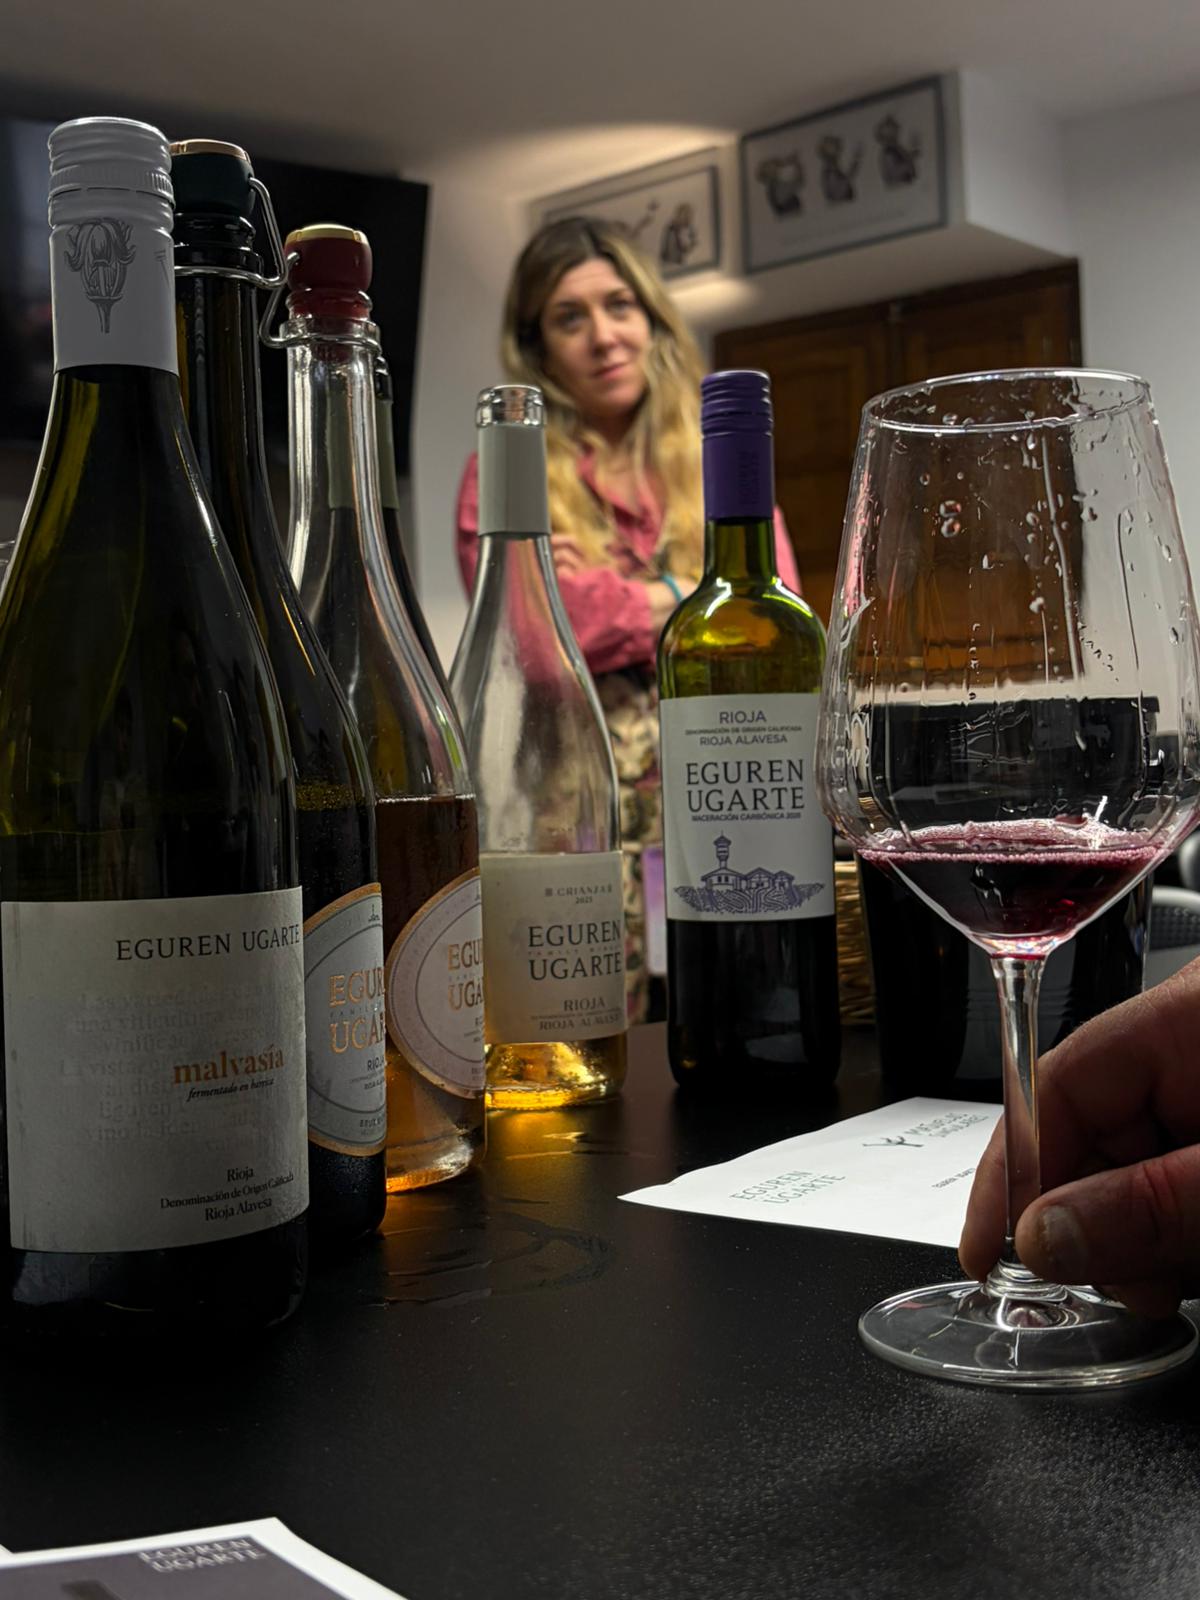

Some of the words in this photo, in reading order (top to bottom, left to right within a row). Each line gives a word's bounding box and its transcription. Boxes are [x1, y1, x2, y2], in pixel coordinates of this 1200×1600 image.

[719, 710, 767, 724] RIOJA
[700, 735, 733, 746] RIOJA
[735, 733, 788, 745] ALAVESA
[686, 759, 804, 786] EGUREN
[687, 787, 806, 813] UGARTE
[116, 933, 232, 962] EGUREN
[242, 924, 302, 952] UGARTE
[528, 920, 621, 948] EGUREN
[447, 938, 483, 971] EGU
[528, 951, 622, 981] UGARTE
[563, 996, 606, 1012] RIOJA
[540, 1019, 576, 1030] RIOJA
[173, 1043, 285, 1085] malvasía
[186, 1082, 237, 1103] fermentado
[239, 1083, 249, 1092] en
[226, 1166, 254, 1182] Rioja
[729, 1170, 813, 1201] EGUREN
[160, 1190, 230, 1209] Denominación
[230, 1187, 242, 1198] de
[242, 1182, 268, 1196] Origen
[762, 1174, 846, 1204] UGARTE
[204, 1204, 235, 1222] Rioja
[236, 1197, 273, 1215] Alavesa
[150, 1548, 267, 1573] UGARTE
